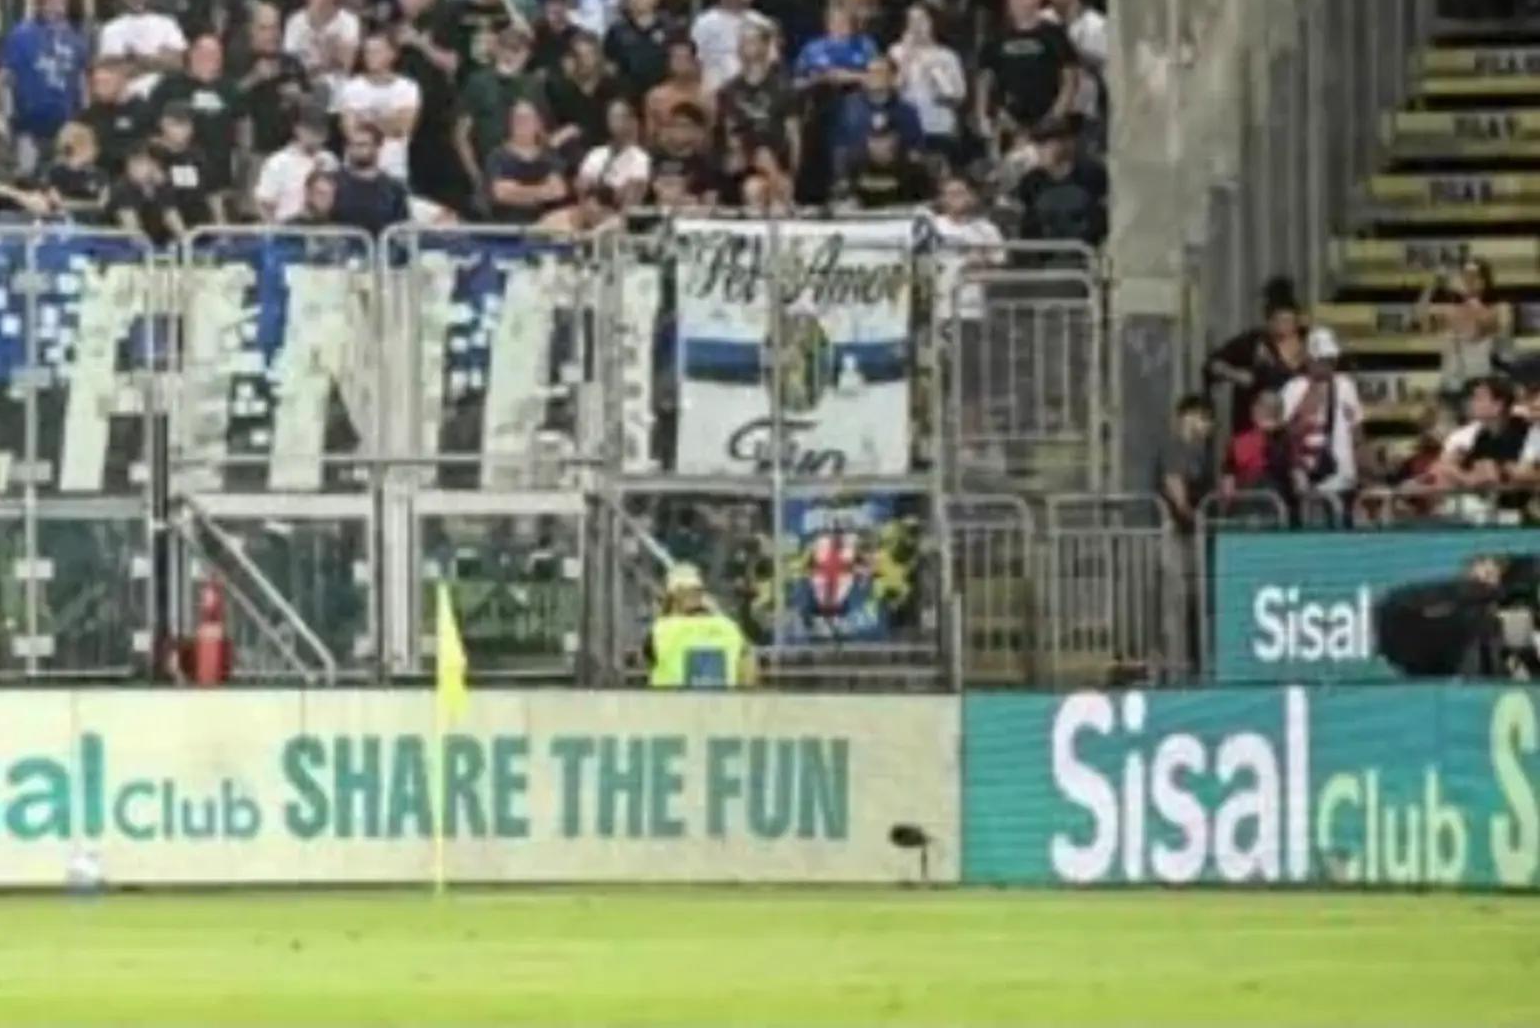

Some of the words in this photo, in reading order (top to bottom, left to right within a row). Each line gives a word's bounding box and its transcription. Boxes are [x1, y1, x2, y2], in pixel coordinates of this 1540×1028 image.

[1252, 585, 1371, 661] Sisal
[113, 779, 263, 841] Club
[282, 734, 531, 841] SHARE
[550, 734, 687, 839] THE
[705, 736, 851, 840] FUN
[1050, 685, 1310, 884] Sisal
[1317, 768, 1468, 883] Club
